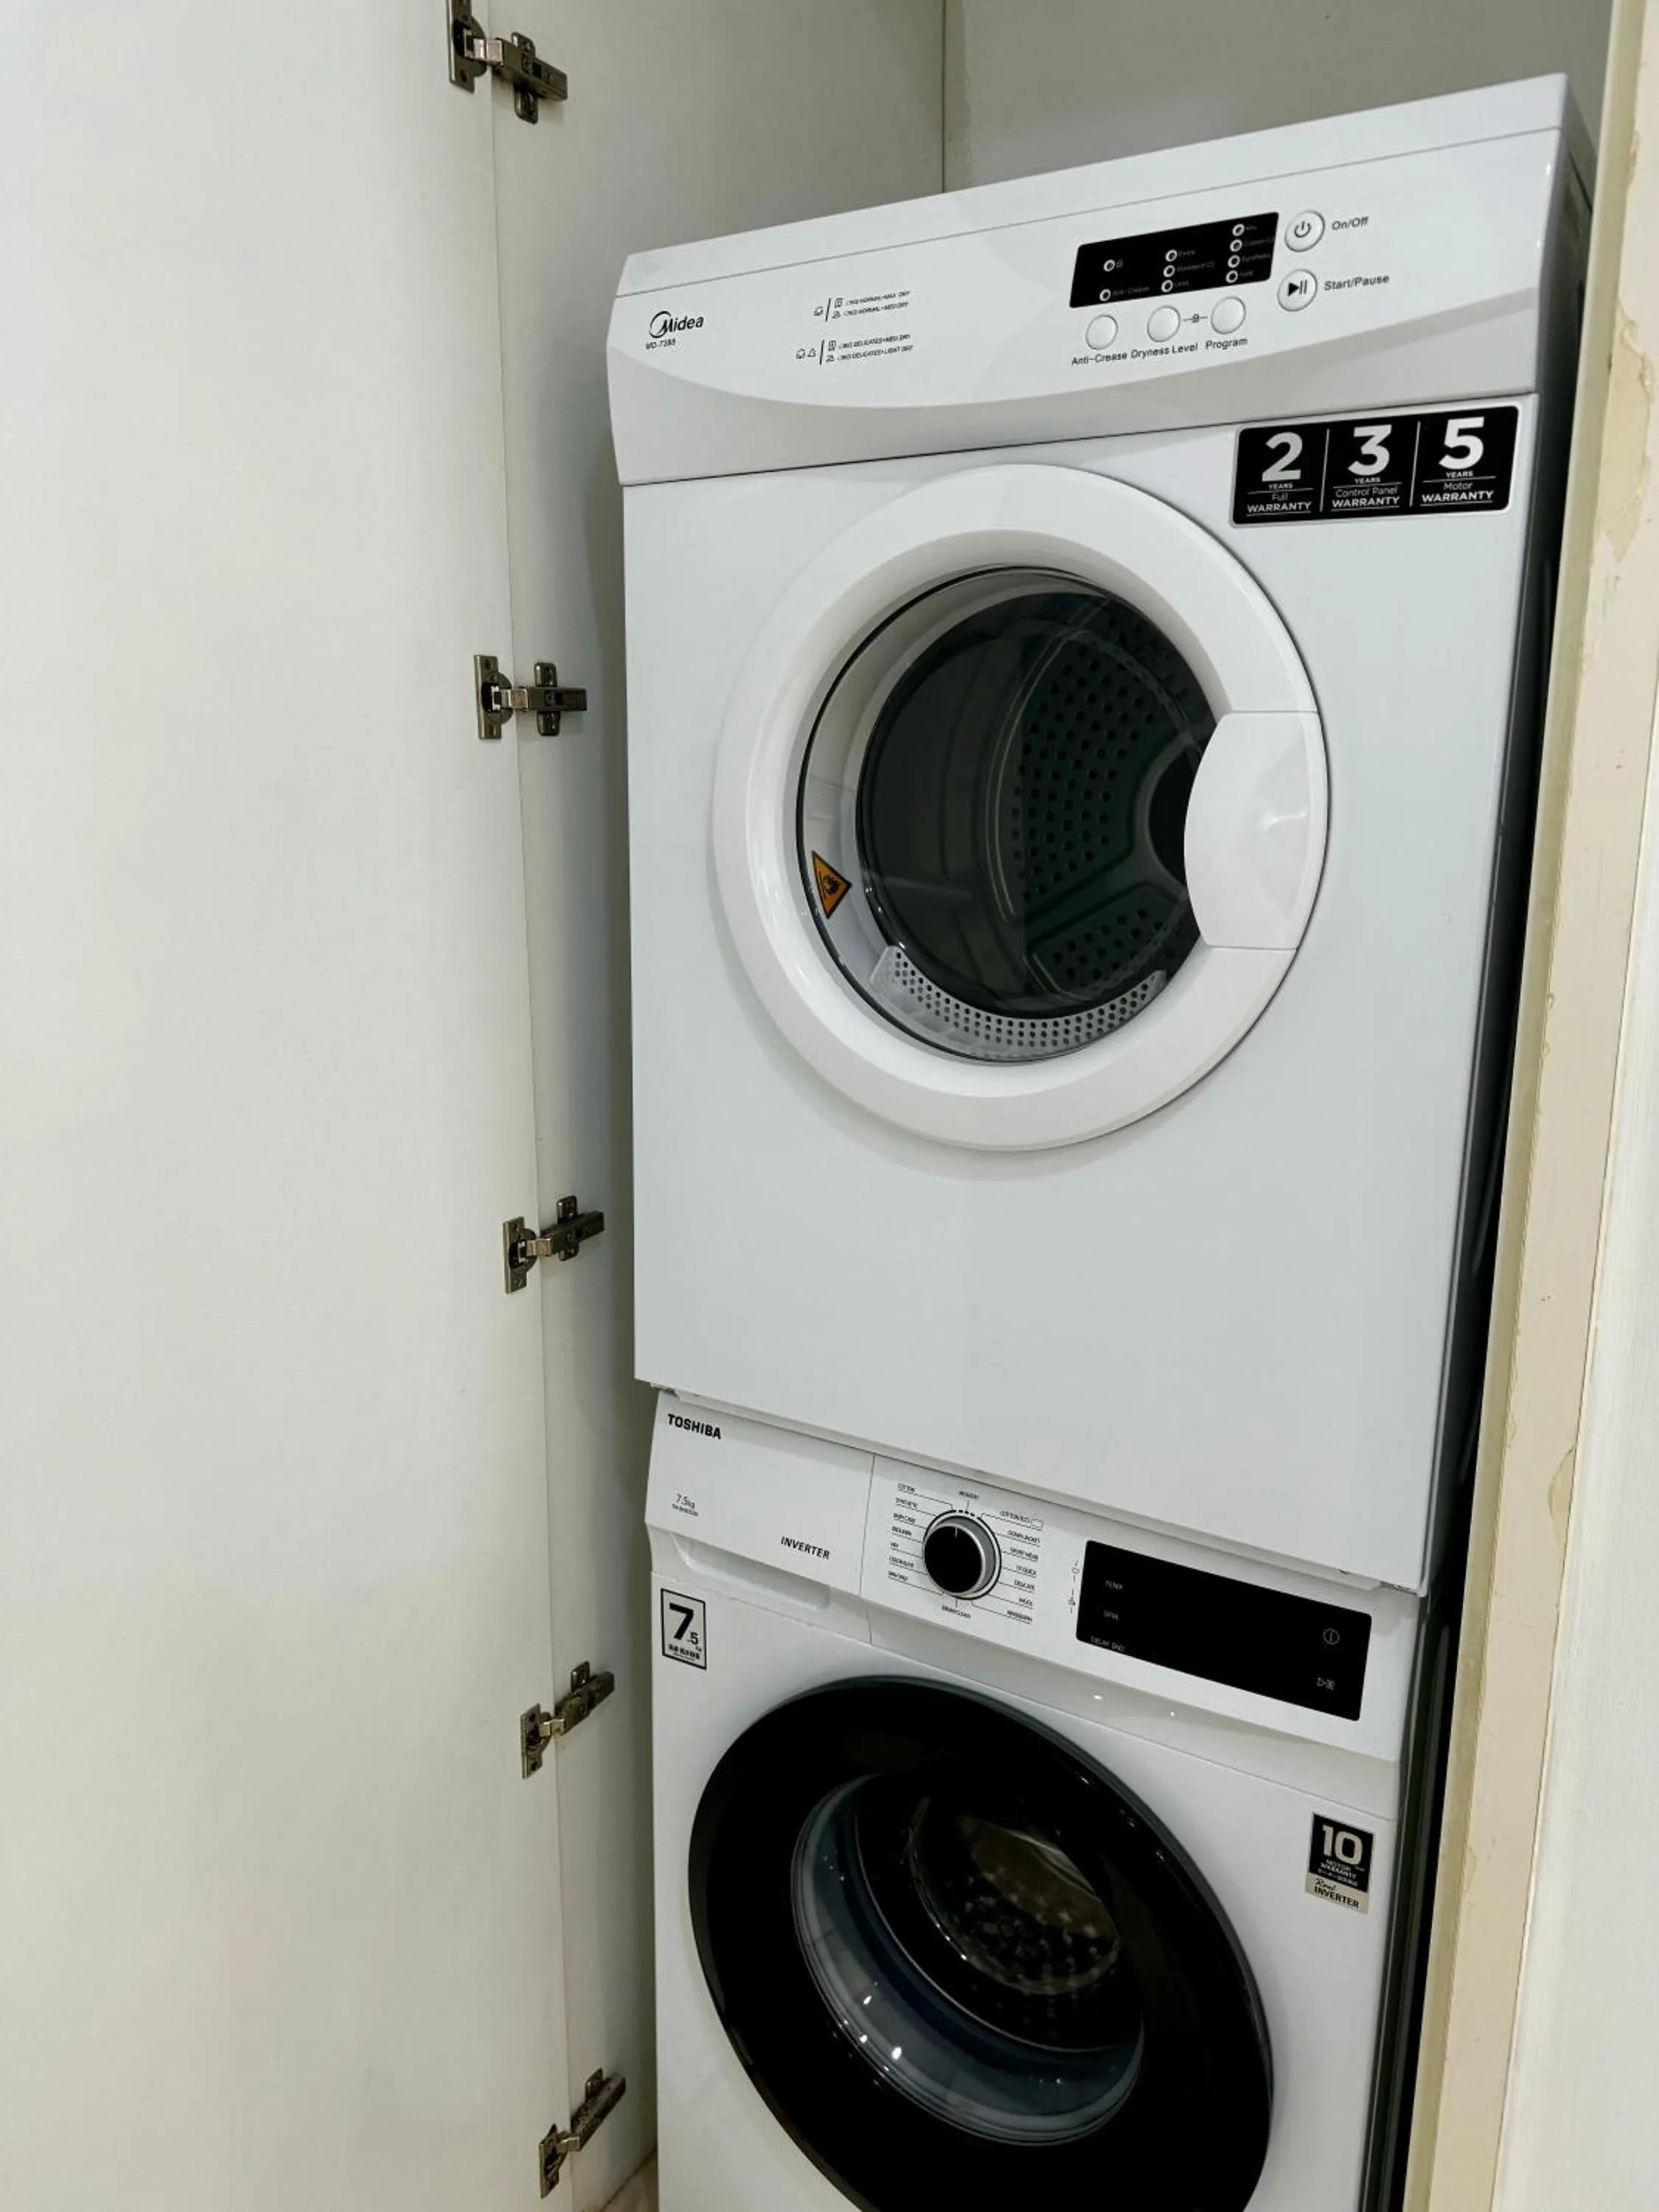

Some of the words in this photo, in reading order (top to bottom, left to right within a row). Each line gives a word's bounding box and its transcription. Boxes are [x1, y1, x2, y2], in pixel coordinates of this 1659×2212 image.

[1332, 216, 1368, 230] On/Off
[1324, 275, 1390, 291] Start/Pause
[649, 310, 704, 338] Midea
[1071, 353, 1127, 365] Anti-Crease
[1130, 348, 1170, 359] Dryness
[1172, 343, 1198, 354] Level
[1206, 338, 1248, 349] Program
[1347, 424, 1392, 476] 3
[1439, 417, 1485, 470] 5
[1262, 431, 1303, 482] 2
[1445, 470, 1474, 479] YEARS
[1335, 487, 1370, 498] Control
[1371, 485, 1398, 496] Panel
[1444, 481, 1473, 491] Motor
[1272, 492, 1288, 502] Full
[1332, 496, 1400, 509] WARRANTY
[1421, 490, 1494, 504] WARRANTY
[1247, 501, 1312, 514] WARRANTY
[667, 1413, 722, 1439] TOSHIBA
[780, 1536, 830, 1559] INVERTER
[1322, 1824, 1363, 1865] 10
[1313, 1885, 1359, 1909] INVERTER
